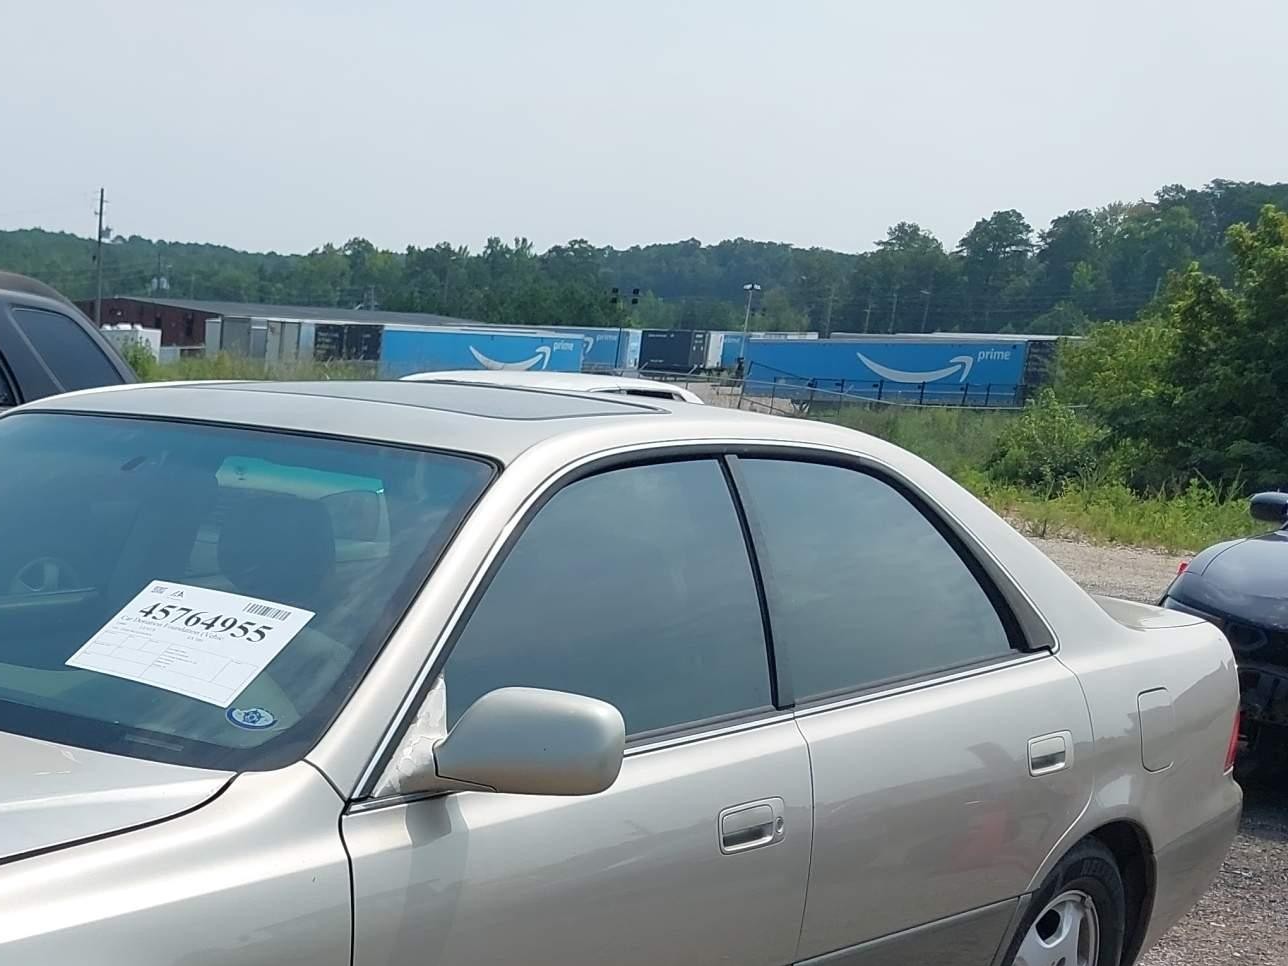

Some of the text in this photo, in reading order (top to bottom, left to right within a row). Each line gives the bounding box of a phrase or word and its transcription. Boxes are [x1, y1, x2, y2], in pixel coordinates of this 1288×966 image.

[553, 340, 574, 353] prime
[977, 348, 1012, 363] prime
[139, 602, 274, 643] 45764955
